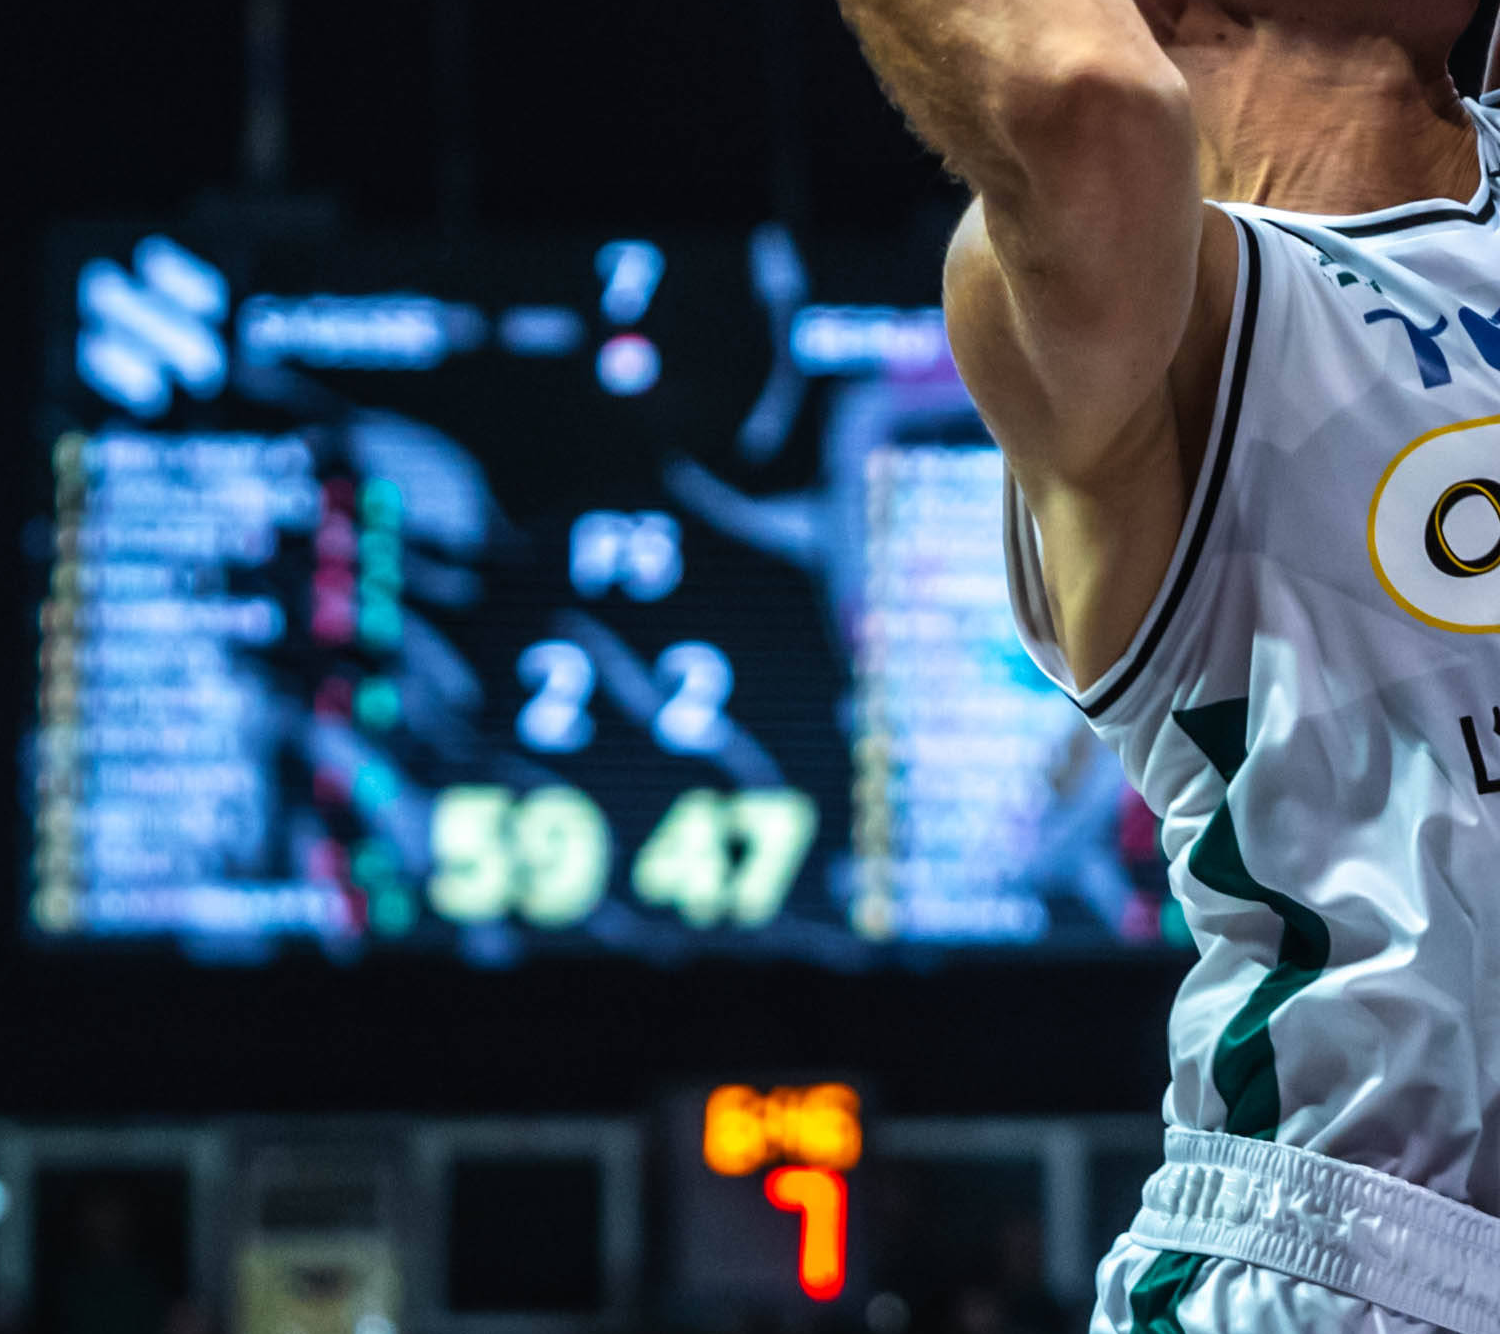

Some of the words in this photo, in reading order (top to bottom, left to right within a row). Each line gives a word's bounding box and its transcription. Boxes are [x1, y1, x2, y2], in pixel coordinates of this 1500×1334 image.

[515, 640, 598, 754] 2
[652, 640, 735, 754] 2
[428, 784, 610, 928] 59
[633, 787, 820, 928] 47
